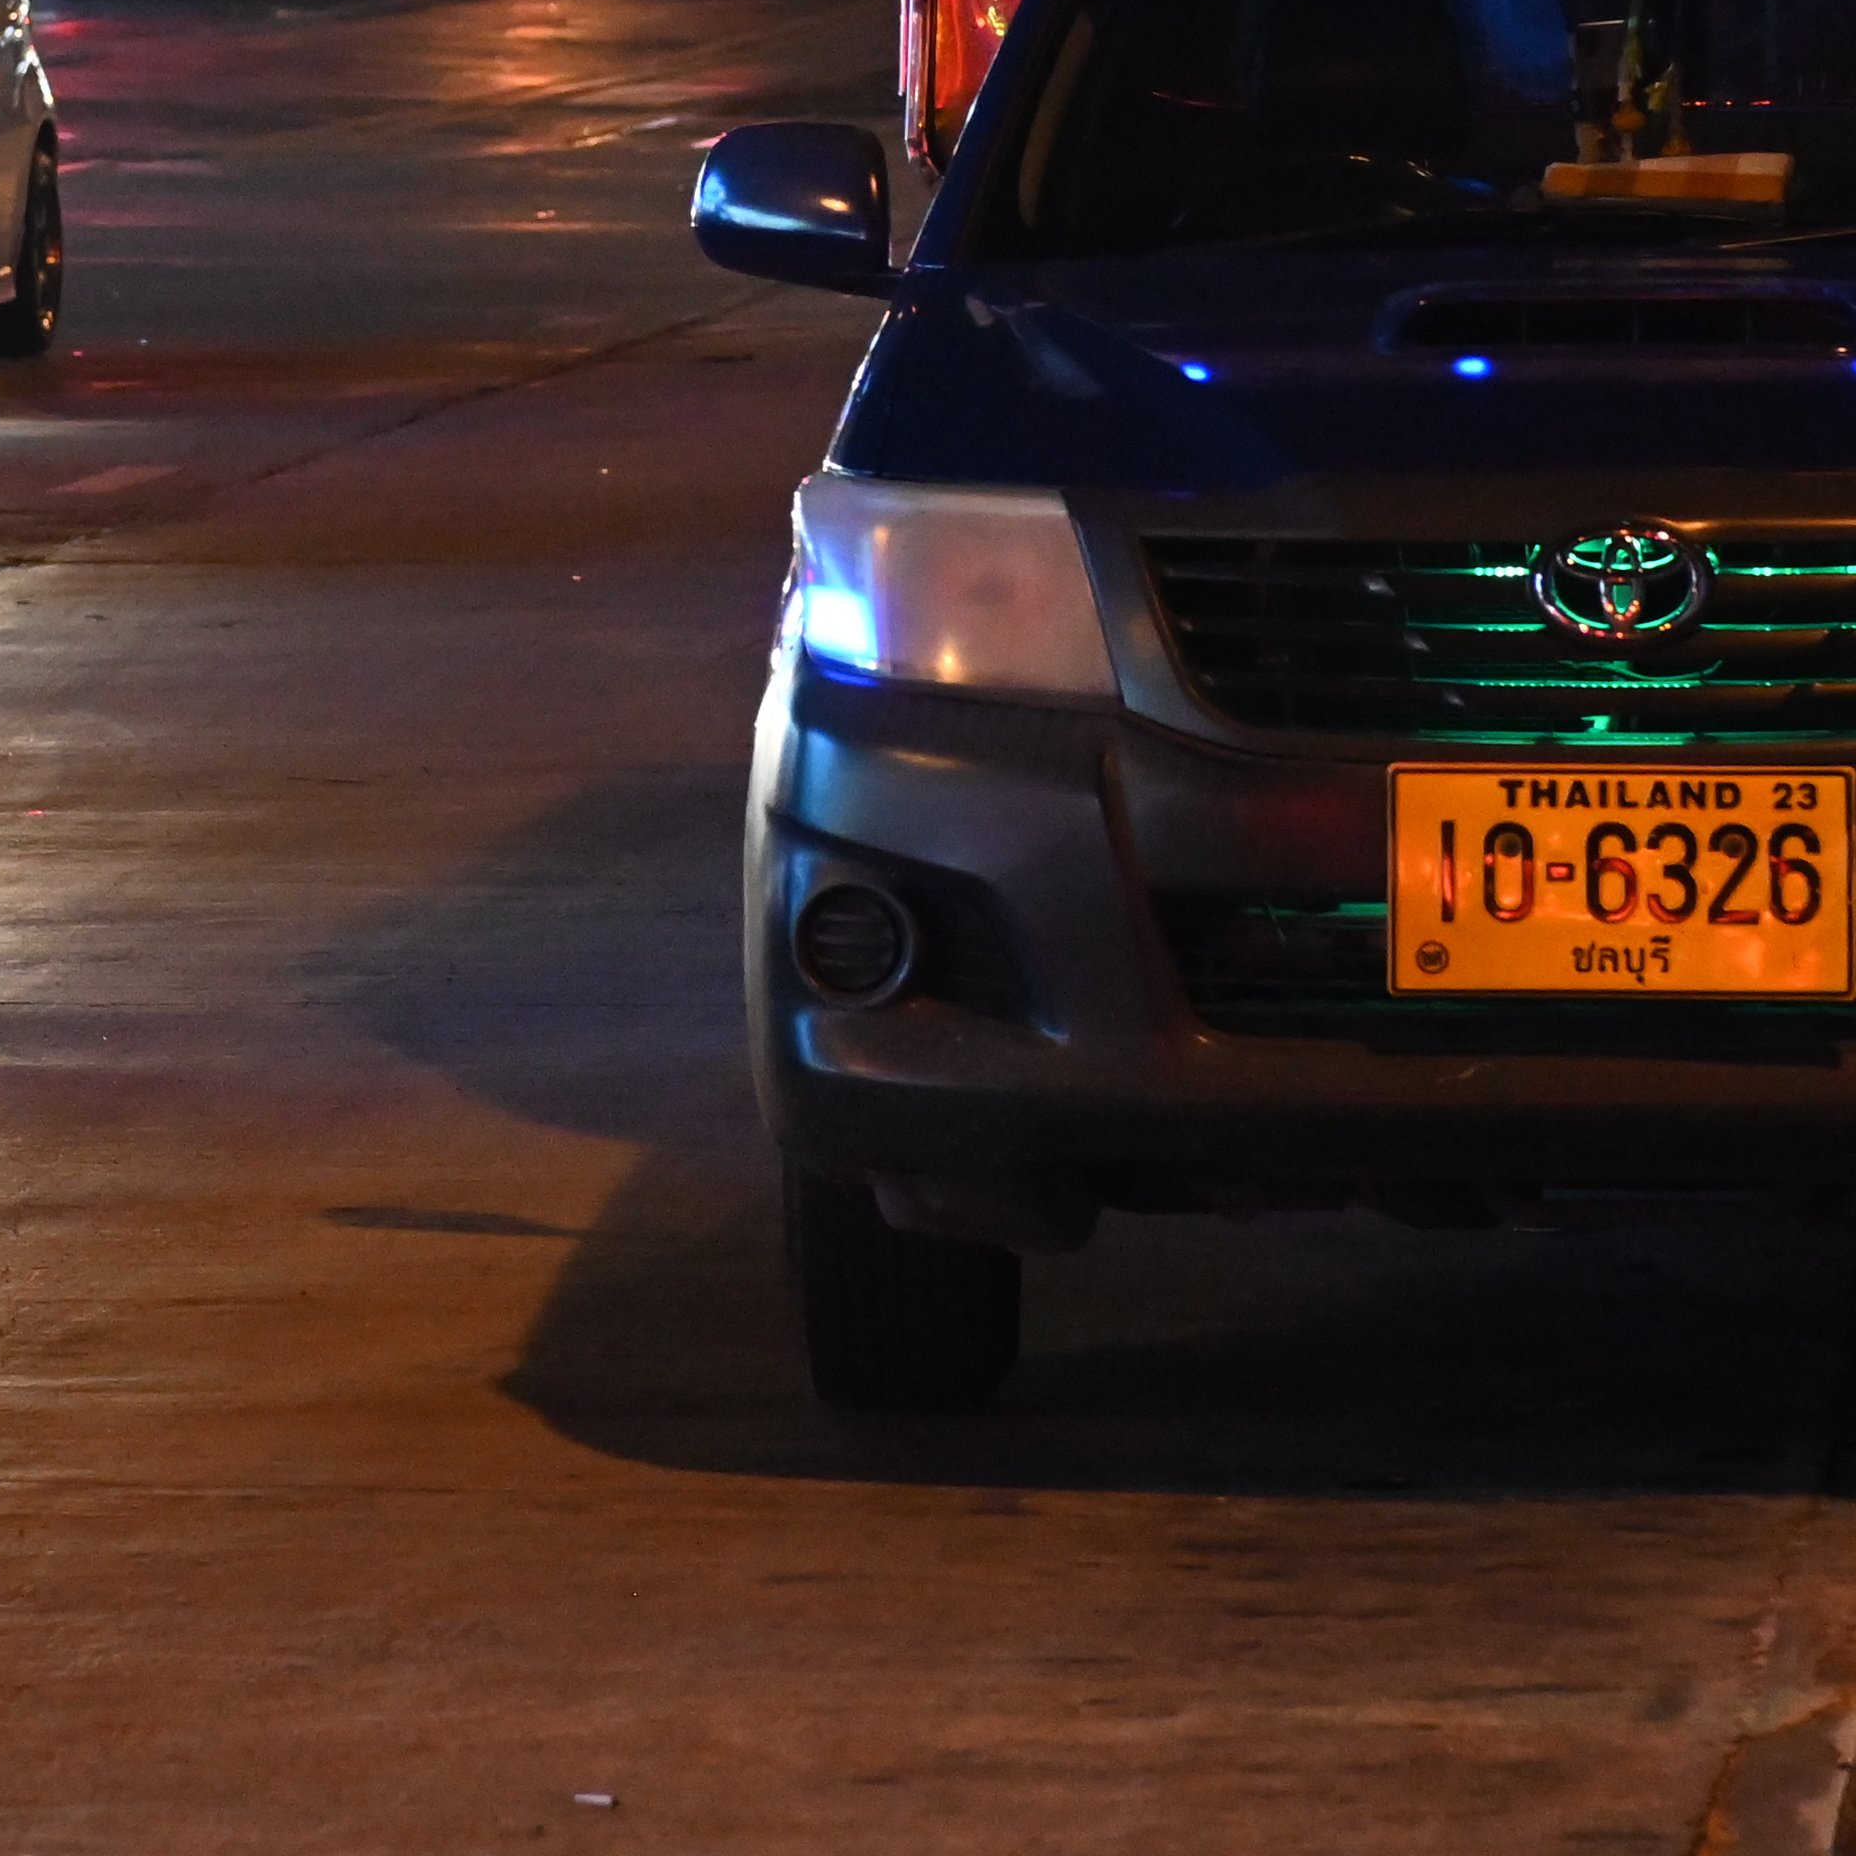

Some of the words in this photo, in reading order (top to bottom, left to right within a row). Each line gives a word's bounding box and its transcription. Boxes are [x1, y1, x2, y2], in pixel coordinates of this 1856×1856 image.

[1498, 780, 1742, 810] THAILAND
[1772, 782, 1818, 810] 23
[1440, 820, 1823, 925] 10-6326
[1571, 935, 1673, 983] ชลบุรี
